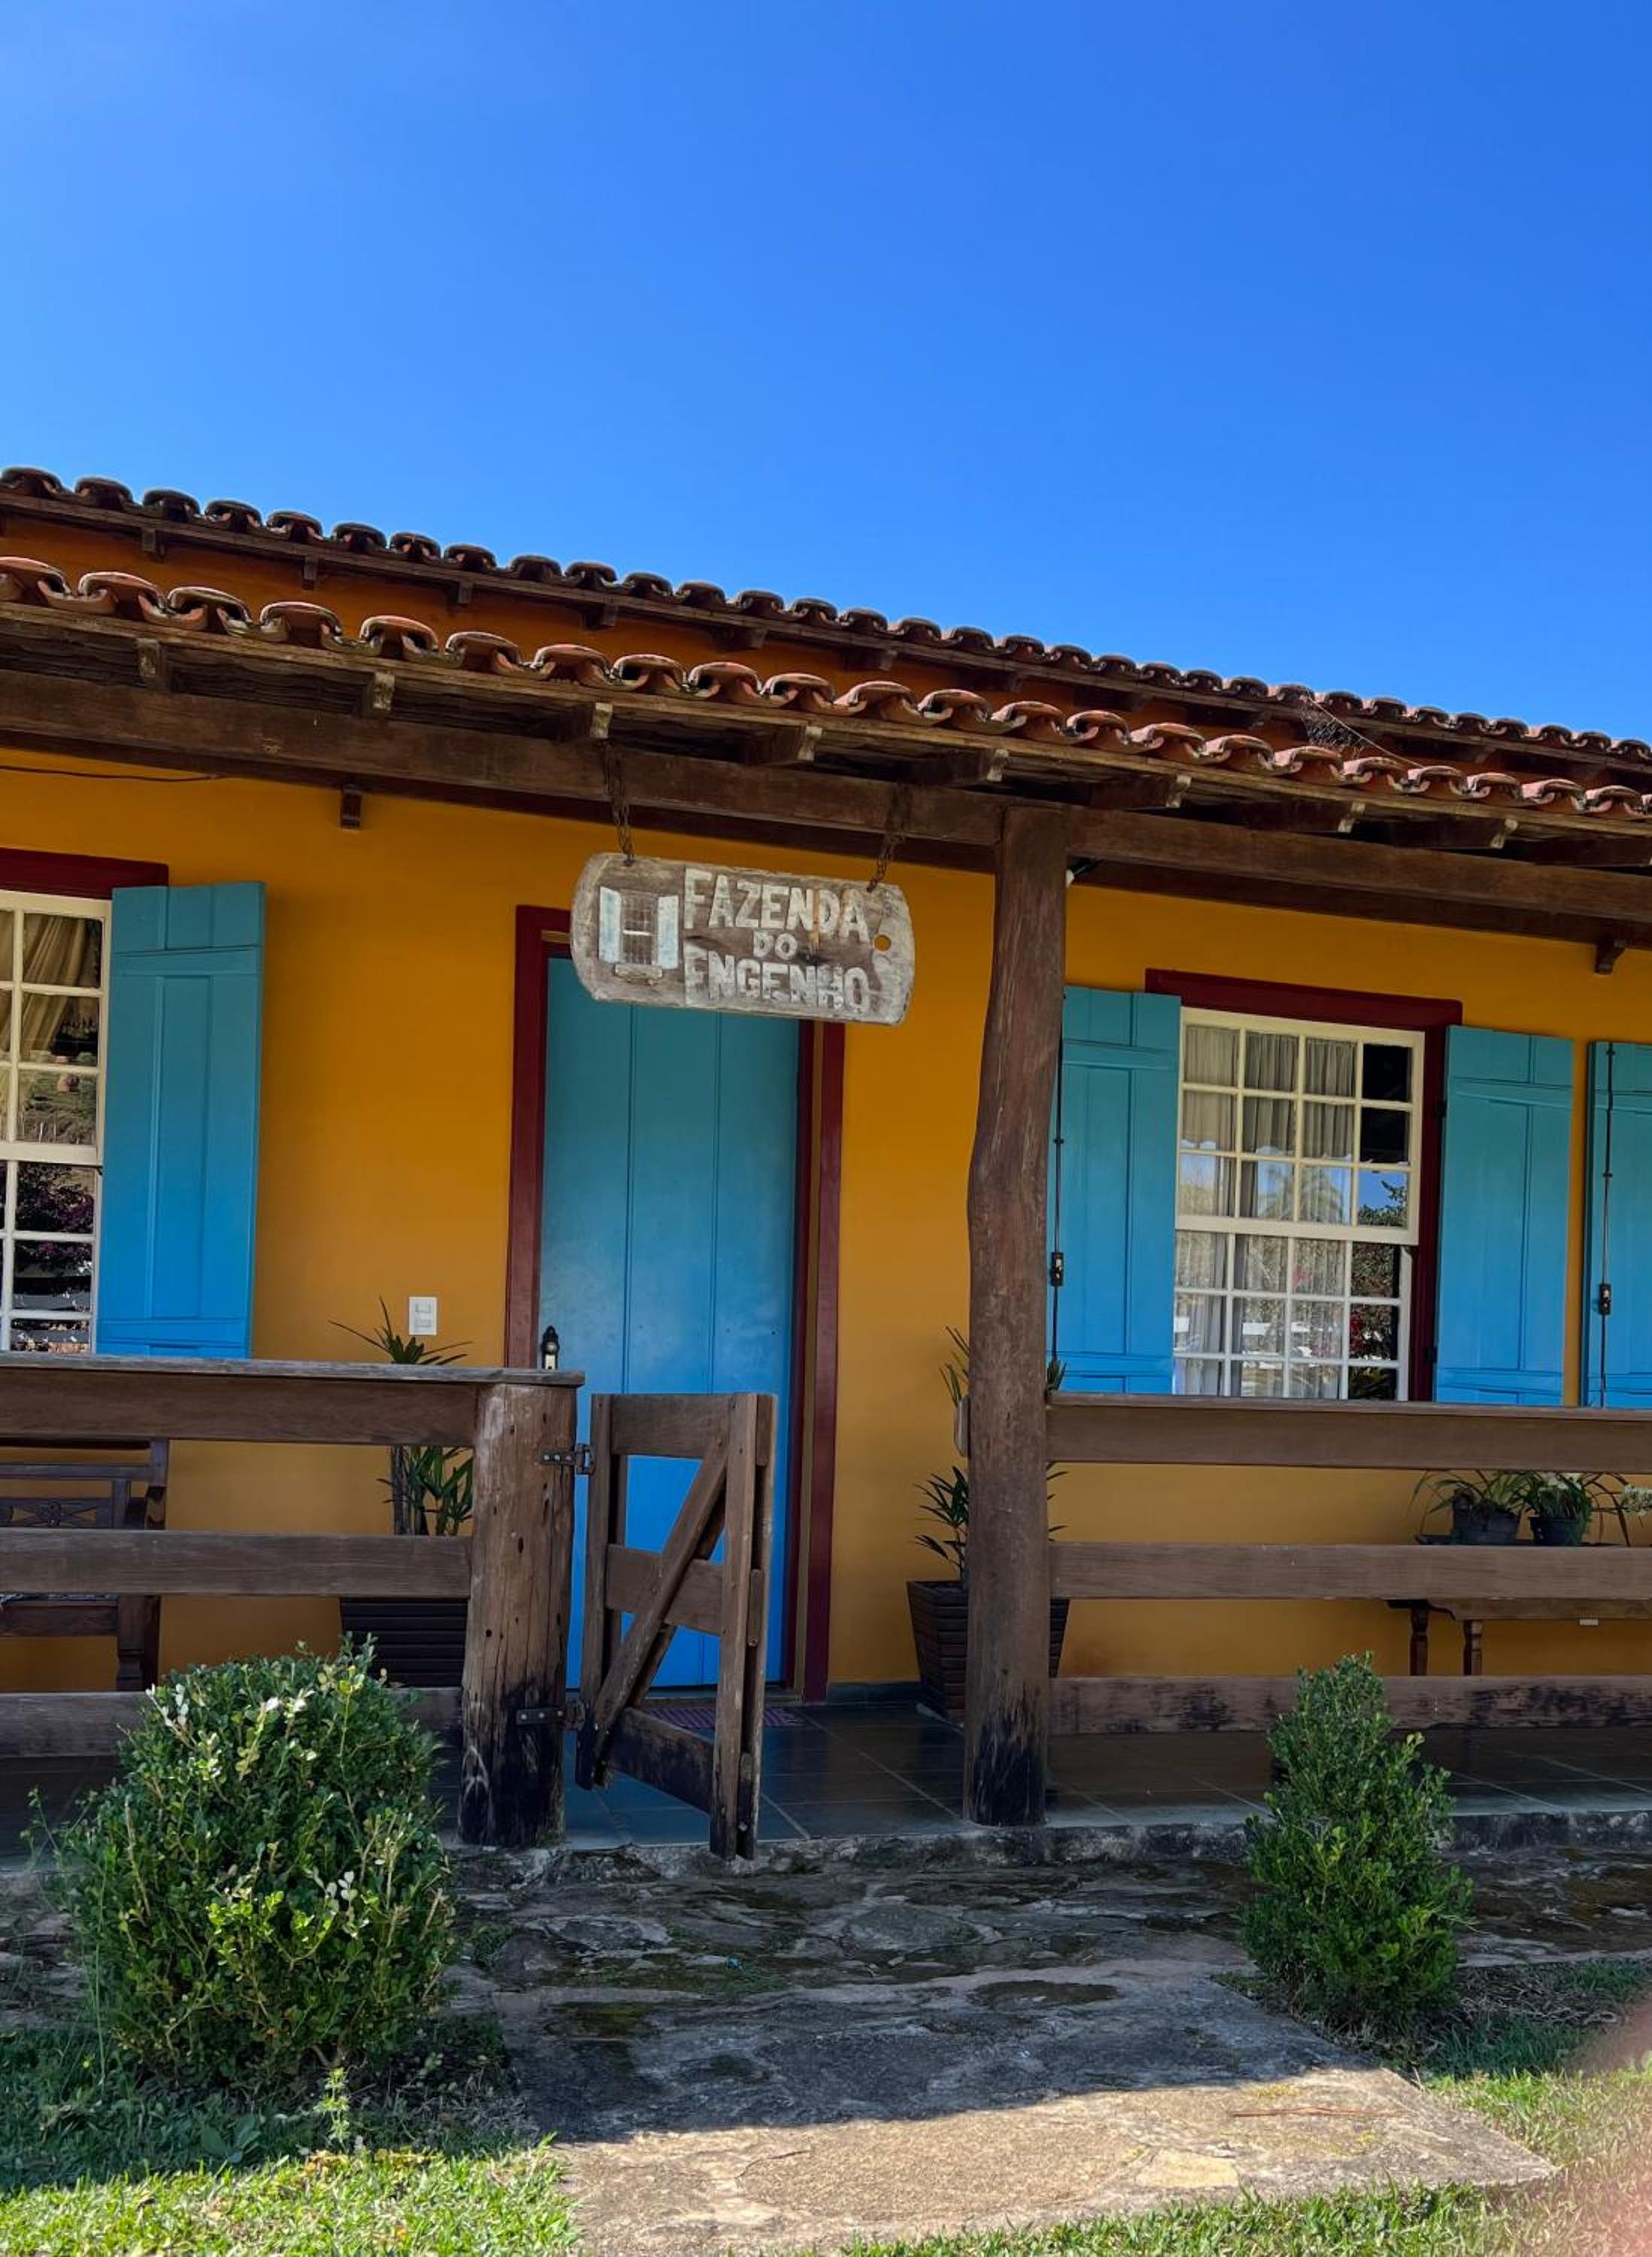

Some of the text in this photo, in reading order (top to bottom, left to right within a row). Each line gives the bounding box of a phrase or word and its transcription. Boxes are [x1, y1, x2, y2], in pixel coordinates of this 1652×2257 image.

[684, 868, 870, 943] FAZENDA
[684, 943, 870, 1013] ENGENHO
[753, 931, 798, 958] DO
